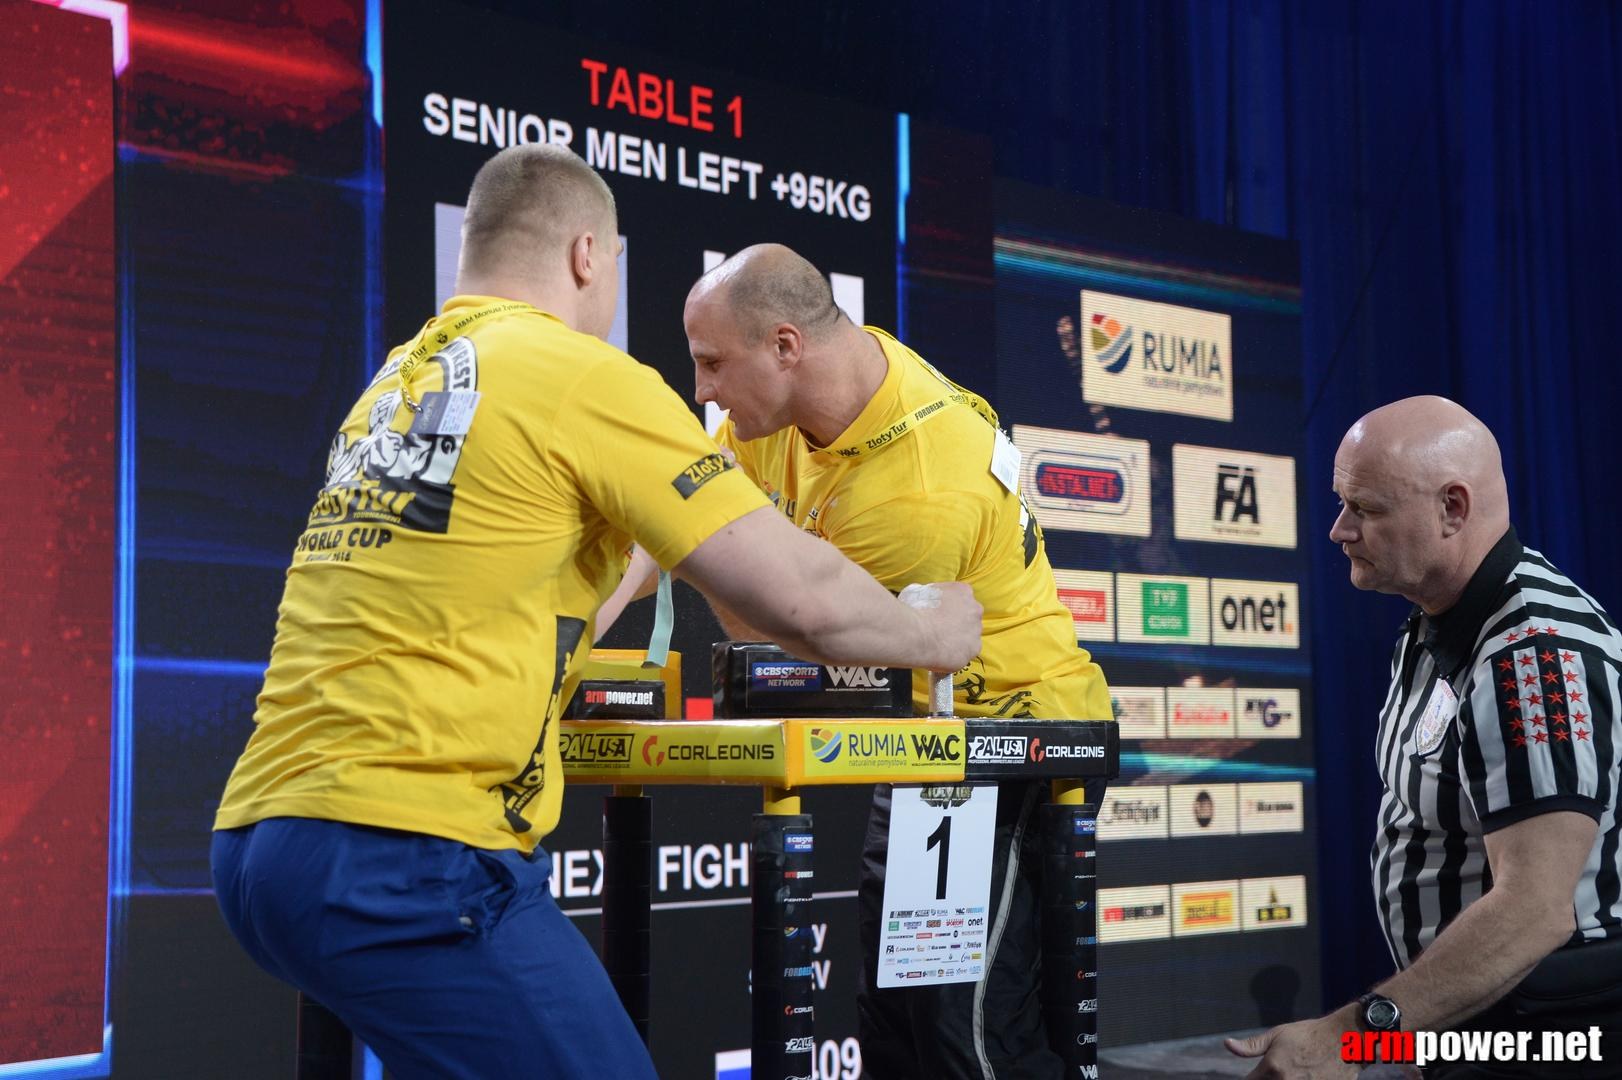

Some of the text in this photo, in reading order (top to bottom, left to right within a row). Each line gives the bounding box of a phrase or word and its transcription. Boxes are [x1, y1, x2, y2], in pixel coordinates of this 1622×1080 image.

[582, 58, 744, 138] TABLE 1
[422, 92, 872, 222] SENIOR MEN LEFT +95KG
[1142, 330, 1224, 380] RUMIA
[297, 528, 393, 552] WORLD CUP
[768, 679, 805, 687] NETWORK
[825, 665, 890, 688] WAC
[585, 690, 653, 706] armpower.net
[668, 744, 775, 761] CORLEONIS
[848, 734, 907, 757] RUMIA
[911, 734, 961, 761] WAC
[1045, 746, 1105, 758] CORLEONIS
[548, 842, 752, 898] NEX FIGH
[926, 816, 952, 900] 1
